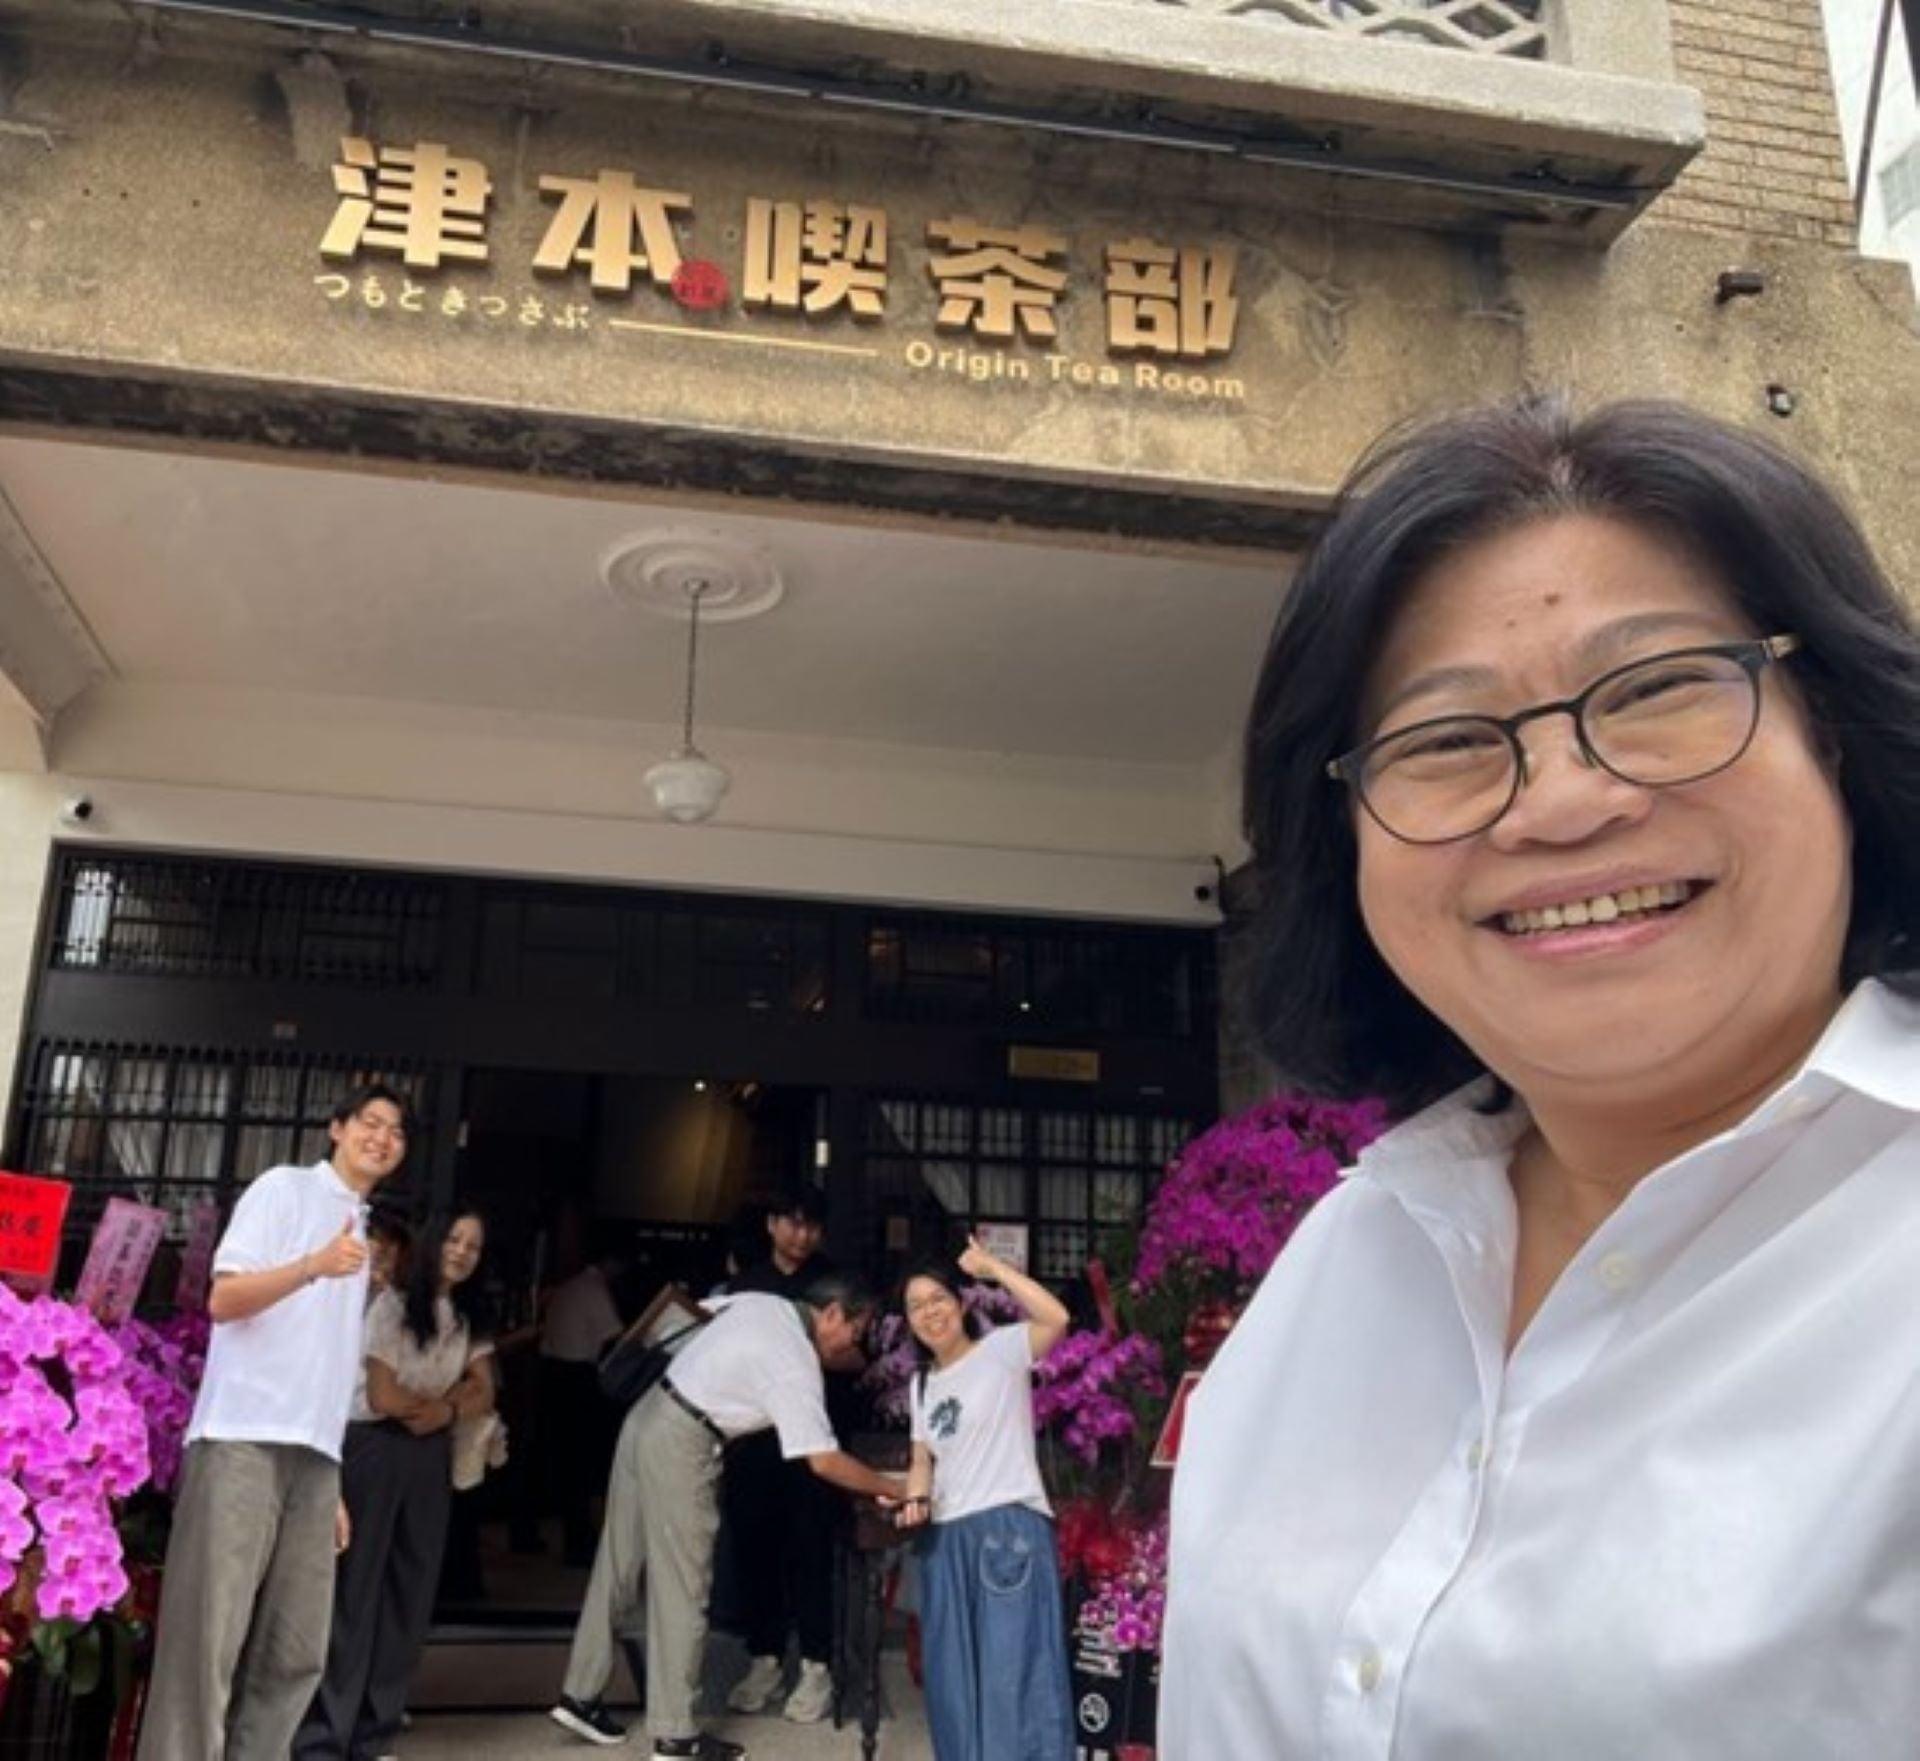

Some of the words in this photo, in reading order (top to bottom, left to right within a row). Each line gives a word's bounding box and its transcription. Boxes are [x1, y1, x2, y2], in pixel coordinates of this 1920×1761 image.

[319, 135, 1240, 356] 津本喫茶部
[905, 341, 1030, 381] Origin
[1045, 353, 1120, 385] Tea
[1134, 362, 1245, 399] Room
